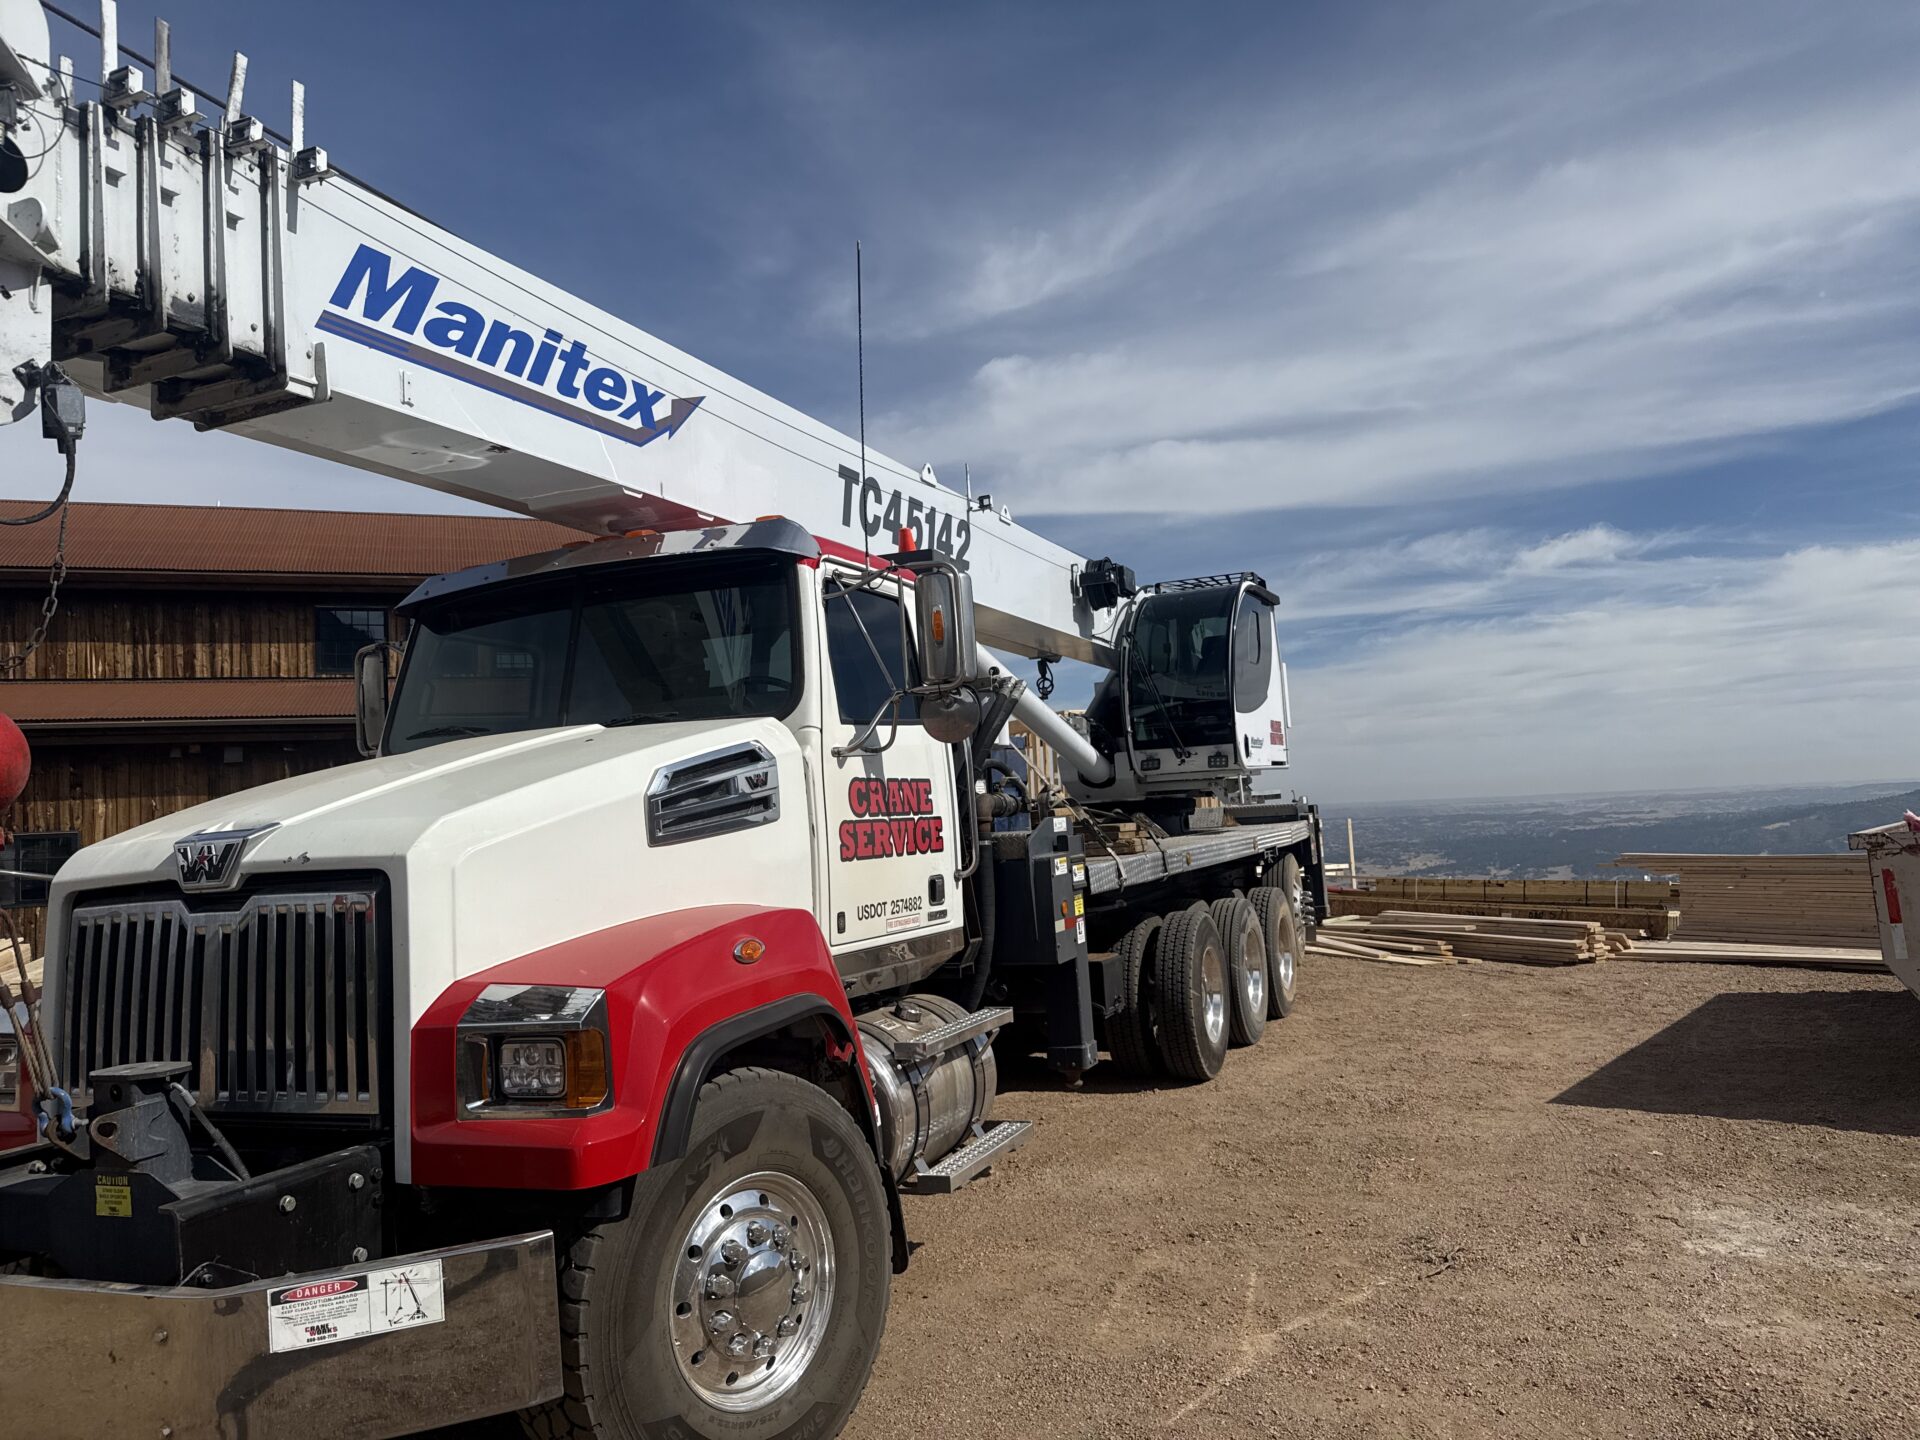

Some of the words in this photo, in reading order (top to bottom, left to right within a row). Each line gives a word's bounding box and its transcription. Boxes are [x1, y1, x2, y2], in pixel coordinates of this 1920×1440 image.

[329, 243, 666, 430] Manitex
[838, 463, 970, 572] TC45142
[848, 777, 933, 818] CRANE
[839, 816, 944, 862] SERVICE
[857, 902, 887, 921] USDOT
[890, 896, 923, 915] 2574882
[97, 1175, 128, 1185] CAUTION
[281, 1298, 333, 1310] ELECTROCUTION
[297, 1283, 340, 1298] DANGER
